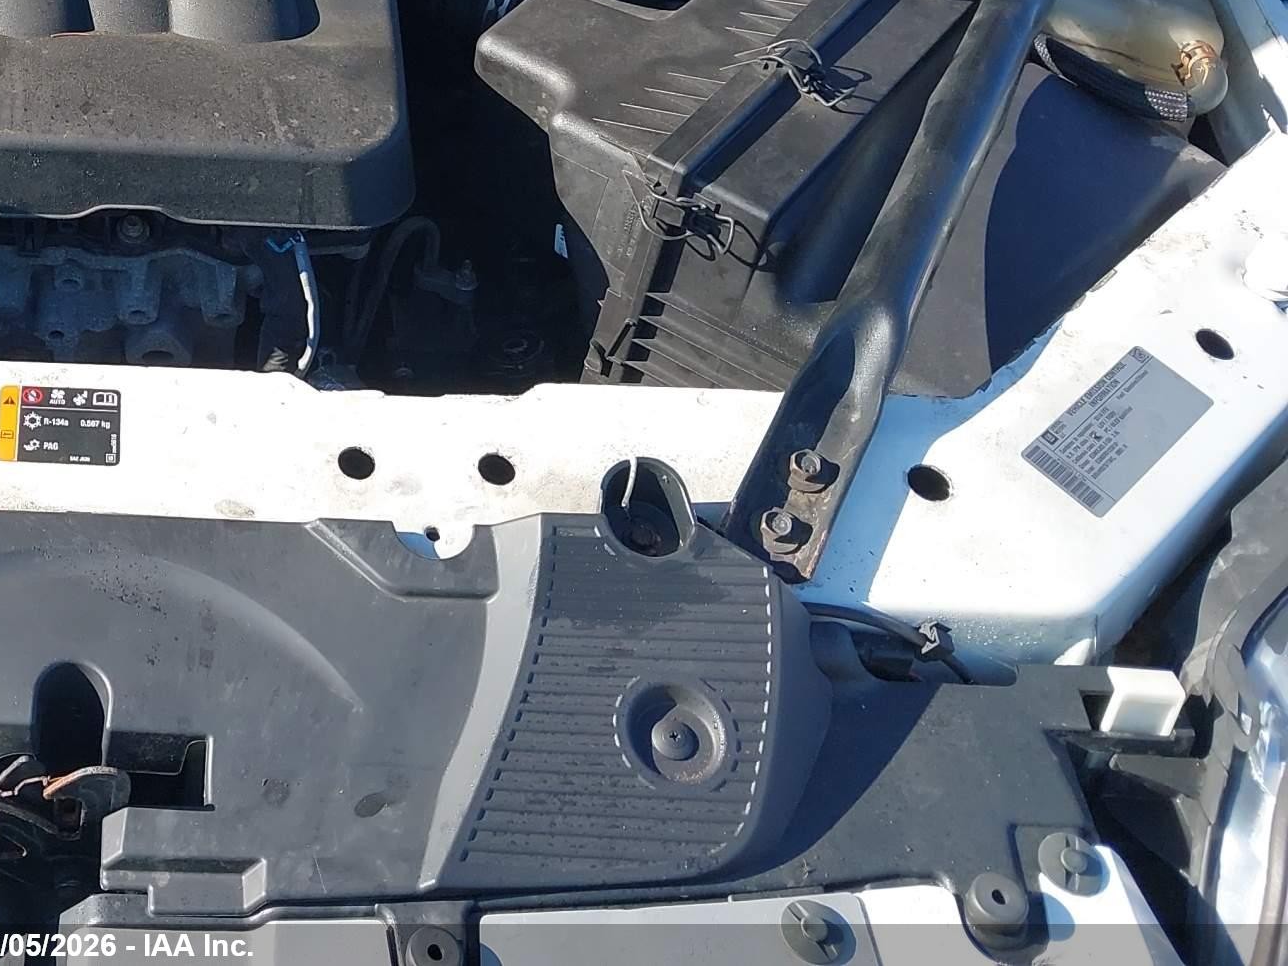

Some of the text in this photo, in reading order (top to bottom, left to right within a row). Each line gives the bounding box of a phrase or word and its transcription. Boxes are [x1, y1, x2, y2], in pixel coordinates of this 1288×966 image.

[1067, 396, 1088, 416] VEHICLE
[1084, 377, 1108, 400] EMISSION
[1088, 379, 1121, 407] INFORMATION
[43, 417, 69, 427] R-134a
[101, 420, 111, 430] kg
[43, 441, 59, 451] PAG
